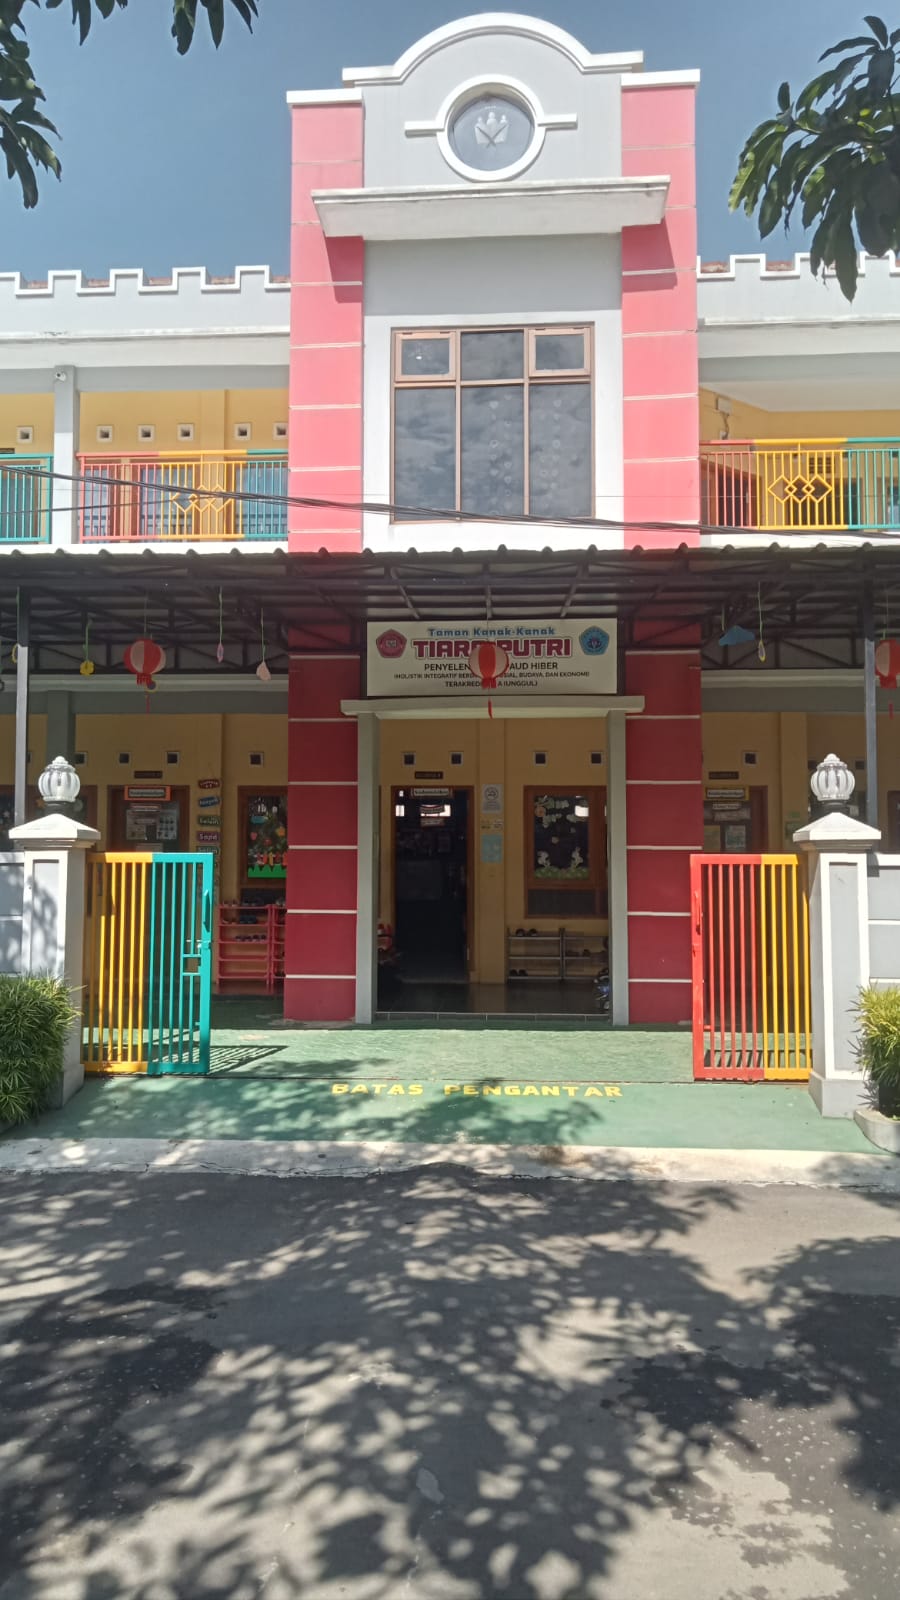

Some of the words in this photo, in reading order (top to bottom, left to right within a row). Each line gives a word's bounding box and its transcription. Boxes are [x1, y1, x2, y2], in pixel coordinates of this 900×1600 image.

[428, 628, 469, 637] Taman
[473, 627, 555, 637] Kanak-Kanak
[413, 640, 485, 658] TIAR
[425, 663, 474, 671] PENYELEN
[508, 662, 528, 670] AUD
[530, 662, 558, 670] HIBER
[331, 1083, 424, 1096] BATAS
[443, 1084, 623, 1098] PENGANTAR
